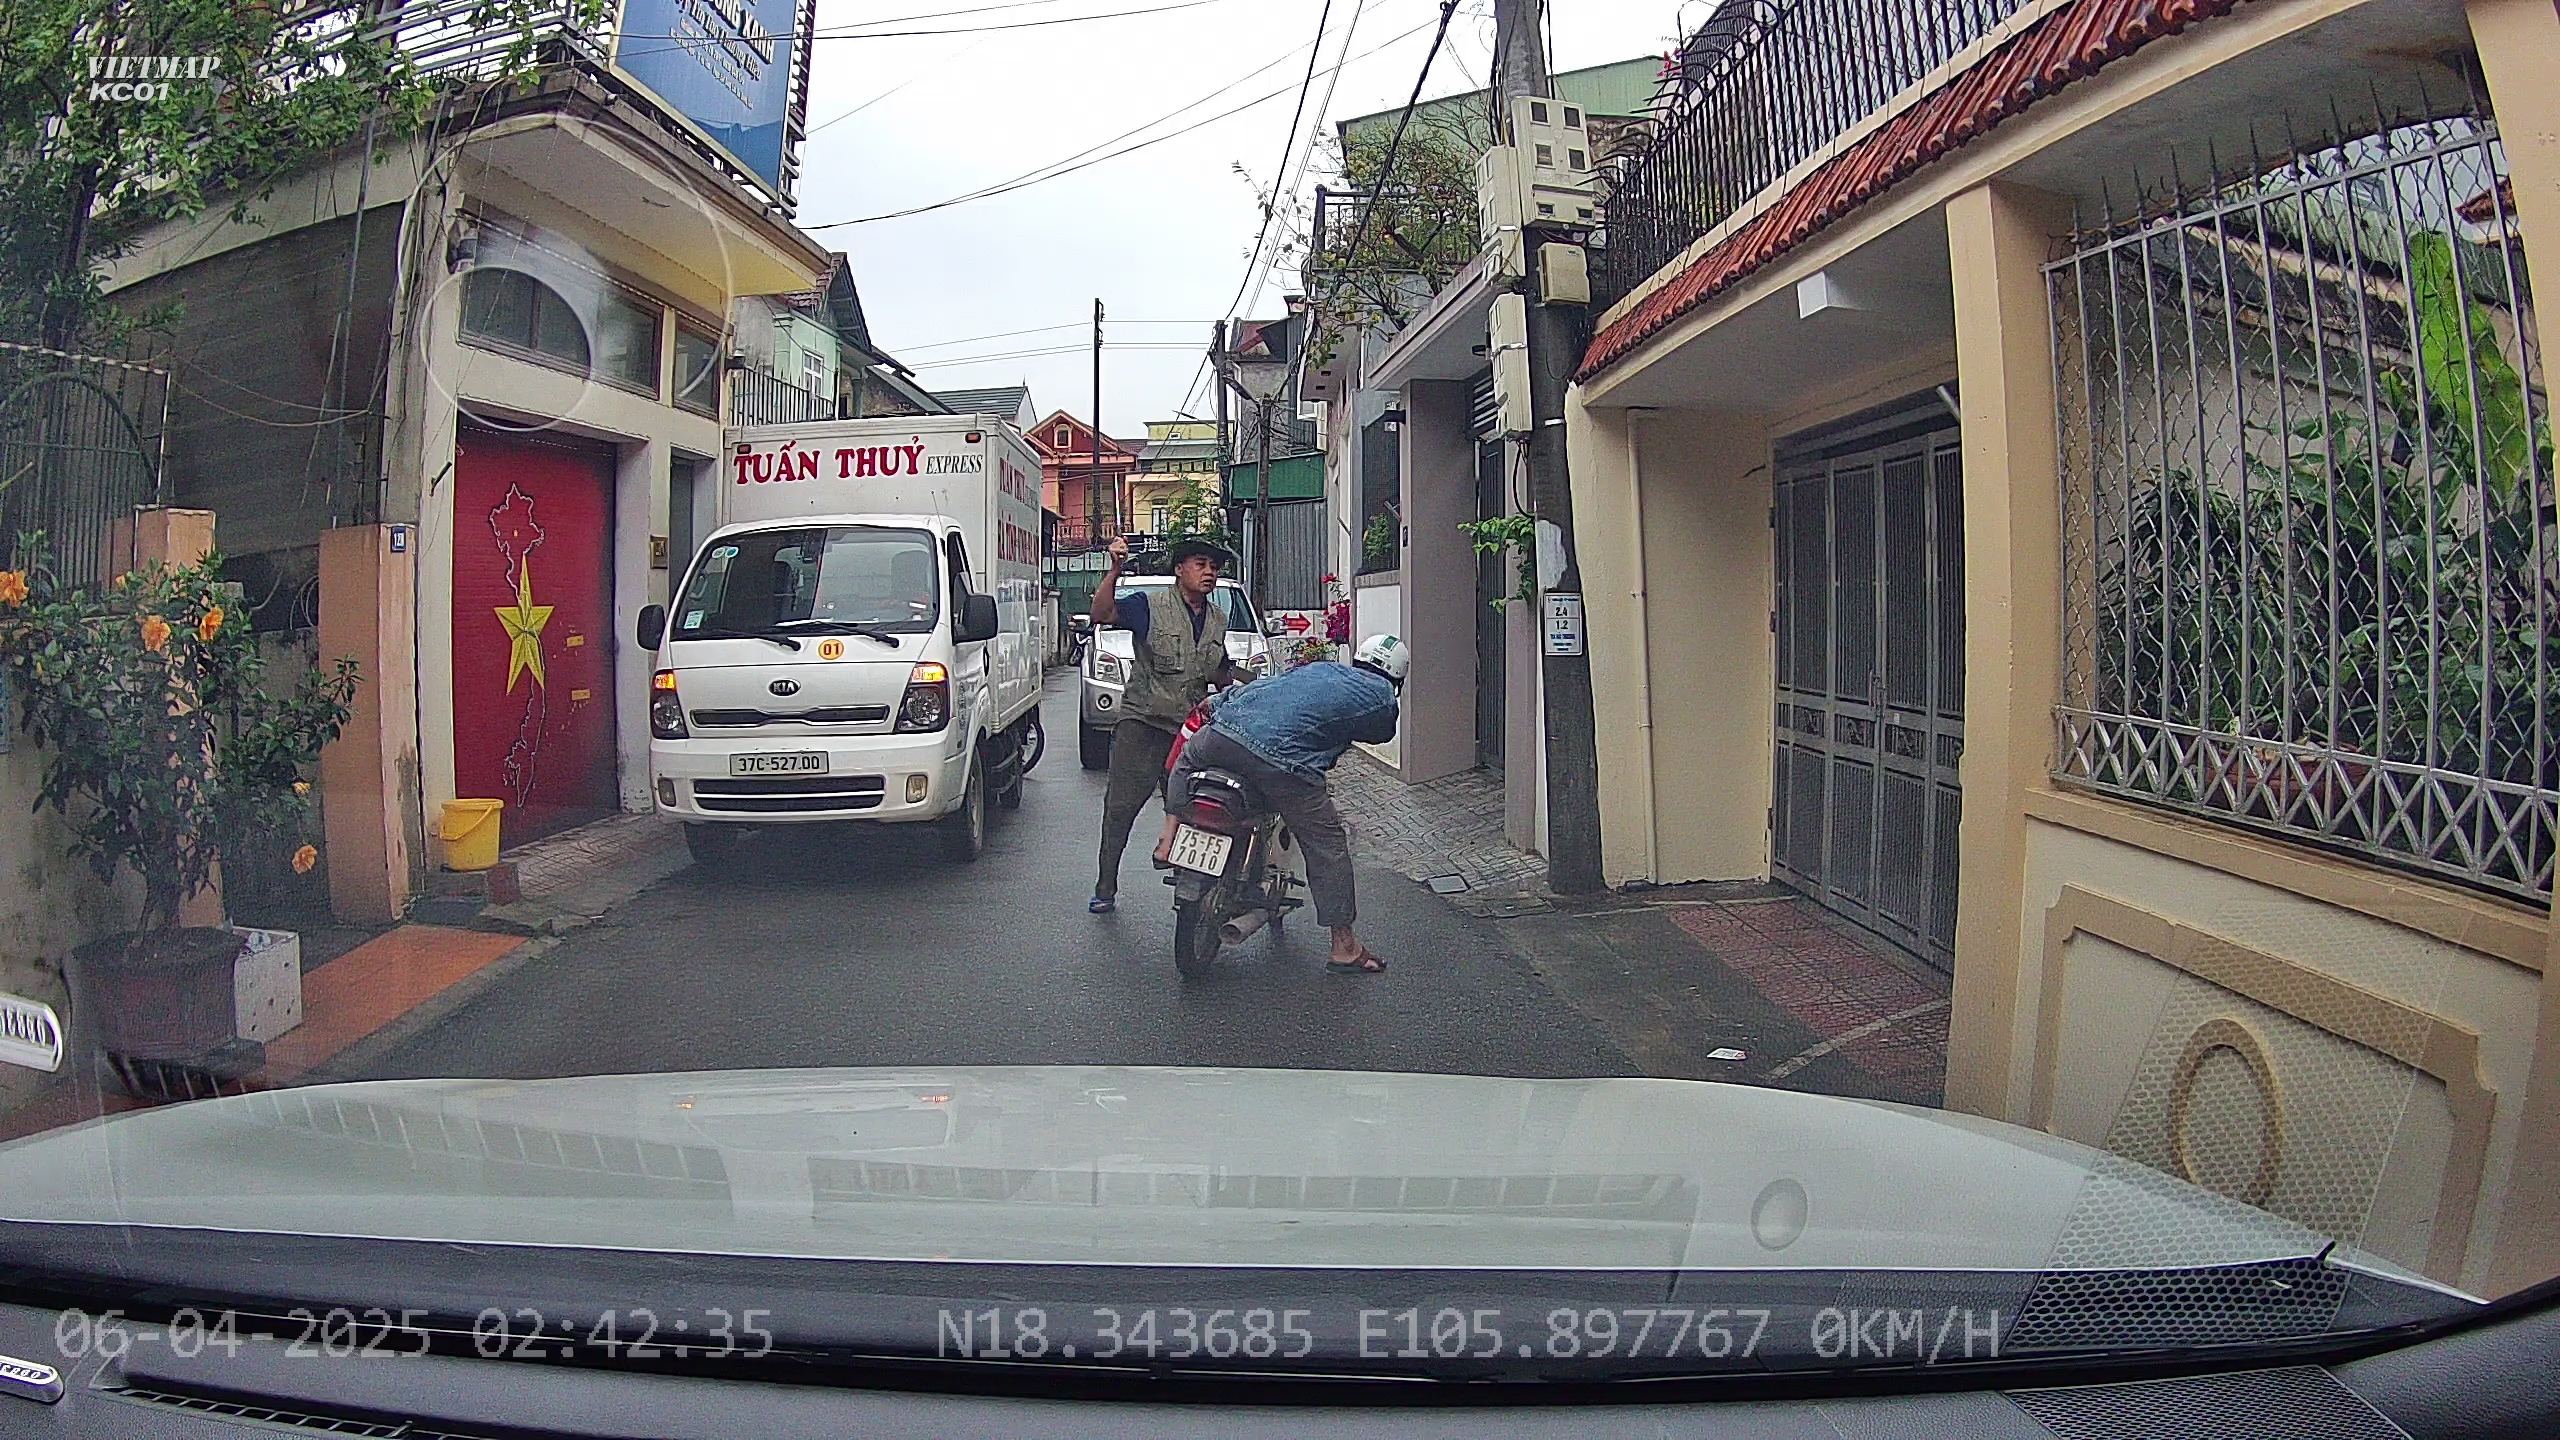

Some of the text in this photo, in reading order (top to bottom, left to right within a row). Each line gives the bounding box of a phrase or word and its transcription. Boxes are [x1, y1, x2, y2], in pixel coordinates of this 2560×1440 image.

[733, 436, 983, 485] TUẤN THUỶ EXPRESS
[823, 643, 841, 656] 01
[773, 682, 796, 693] KIA
[738, 756, 820, 772] 37C-527.00
[1181, 829, 1224, 855] 75-F5
[1176, 846, 1218, 871] 7010
